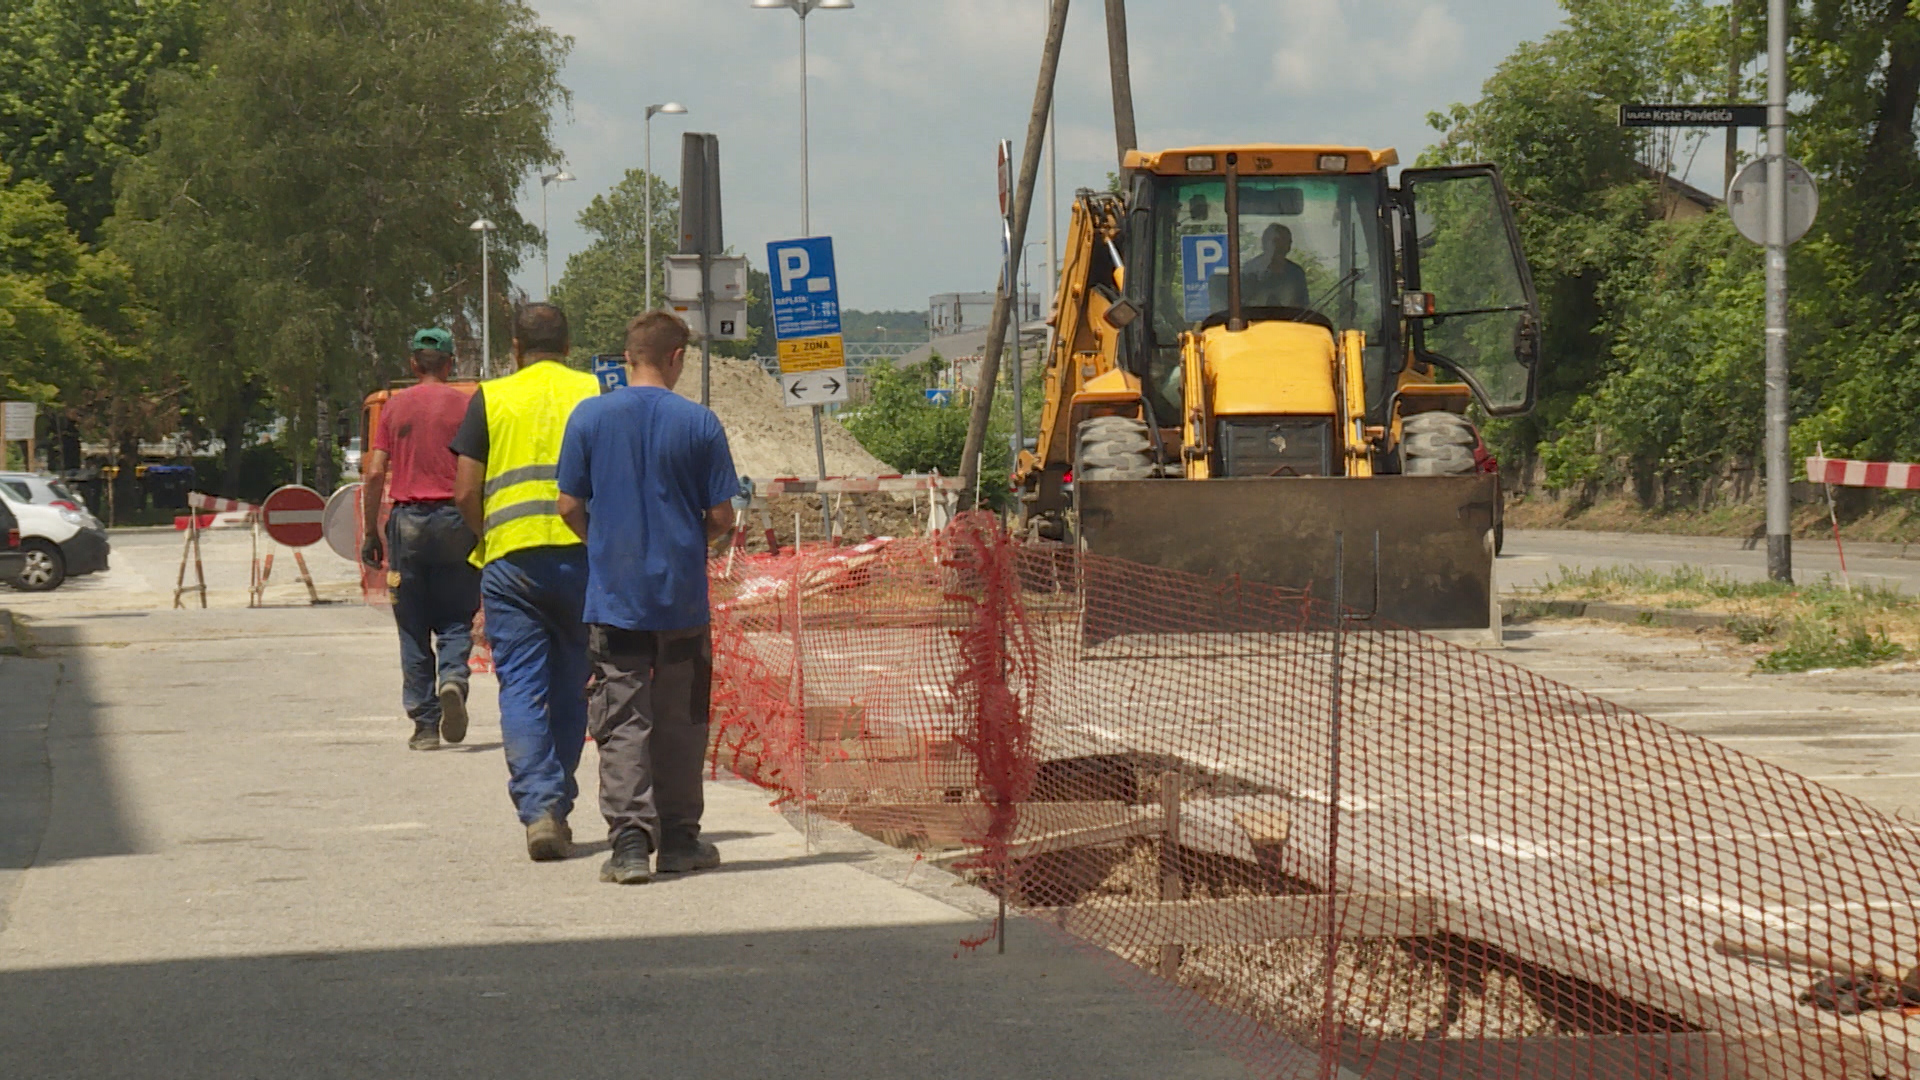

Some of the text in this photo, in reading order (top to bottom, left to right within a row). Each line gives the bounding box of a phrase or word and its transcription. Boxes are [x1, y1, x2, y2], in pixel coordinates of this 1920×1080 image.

[1653, 110, 1682, 121] Krste
[1684, 109, 1733, 121] Pavletića
[778, 247, 810, 292] P
[1196, 240, 1222, 280] P
[803, 341, 830, 351] ZONA
